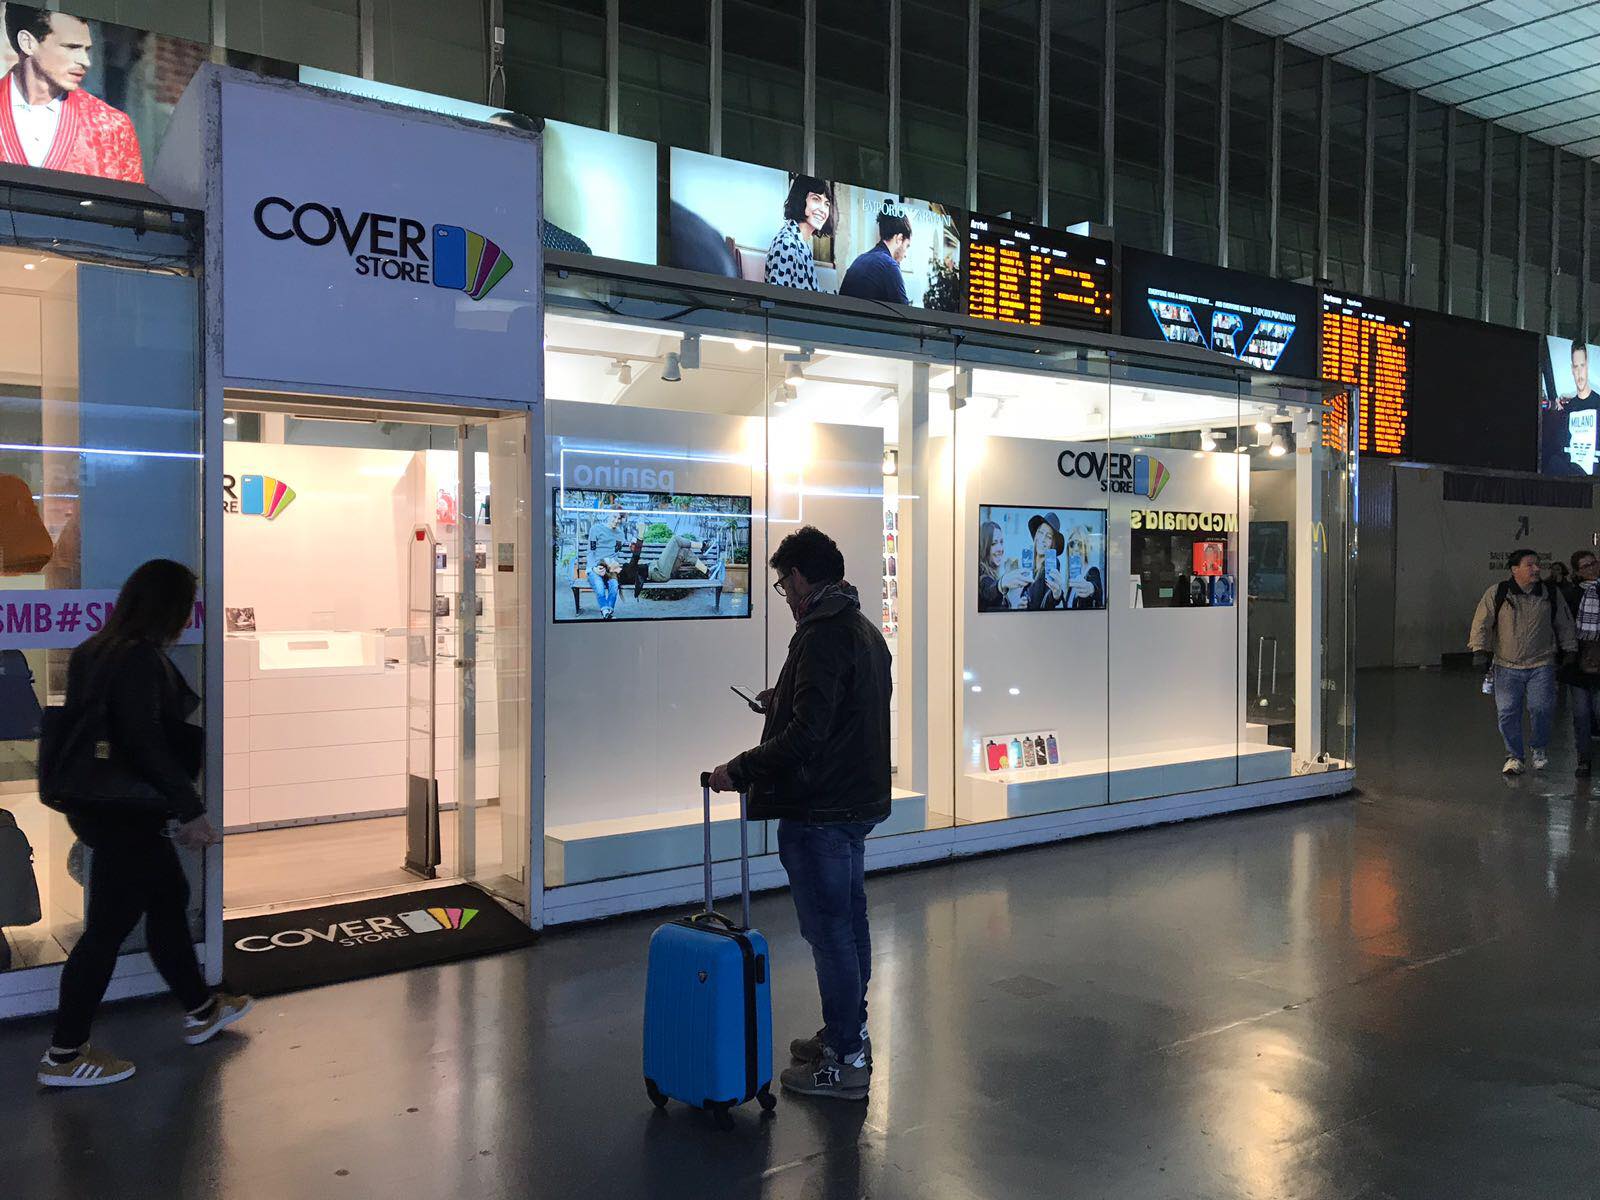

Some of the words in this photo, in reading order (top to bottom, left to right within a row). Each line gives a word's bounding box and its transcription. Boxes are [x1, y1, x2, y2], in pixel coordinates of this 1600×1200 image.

[862, 198, 904, 218] EMPORIO
[254, 197, 429, 261] COVER
[355, 255, 430, 284] STORE
[1571, 415, 1593, 428] MILANO
[1058, 450, 1132, 481] COVER
[1101, 480, 1133, 493] STORE
[234, 916, 401, 952] COVER
[339, 928, 410, 947] STORE
